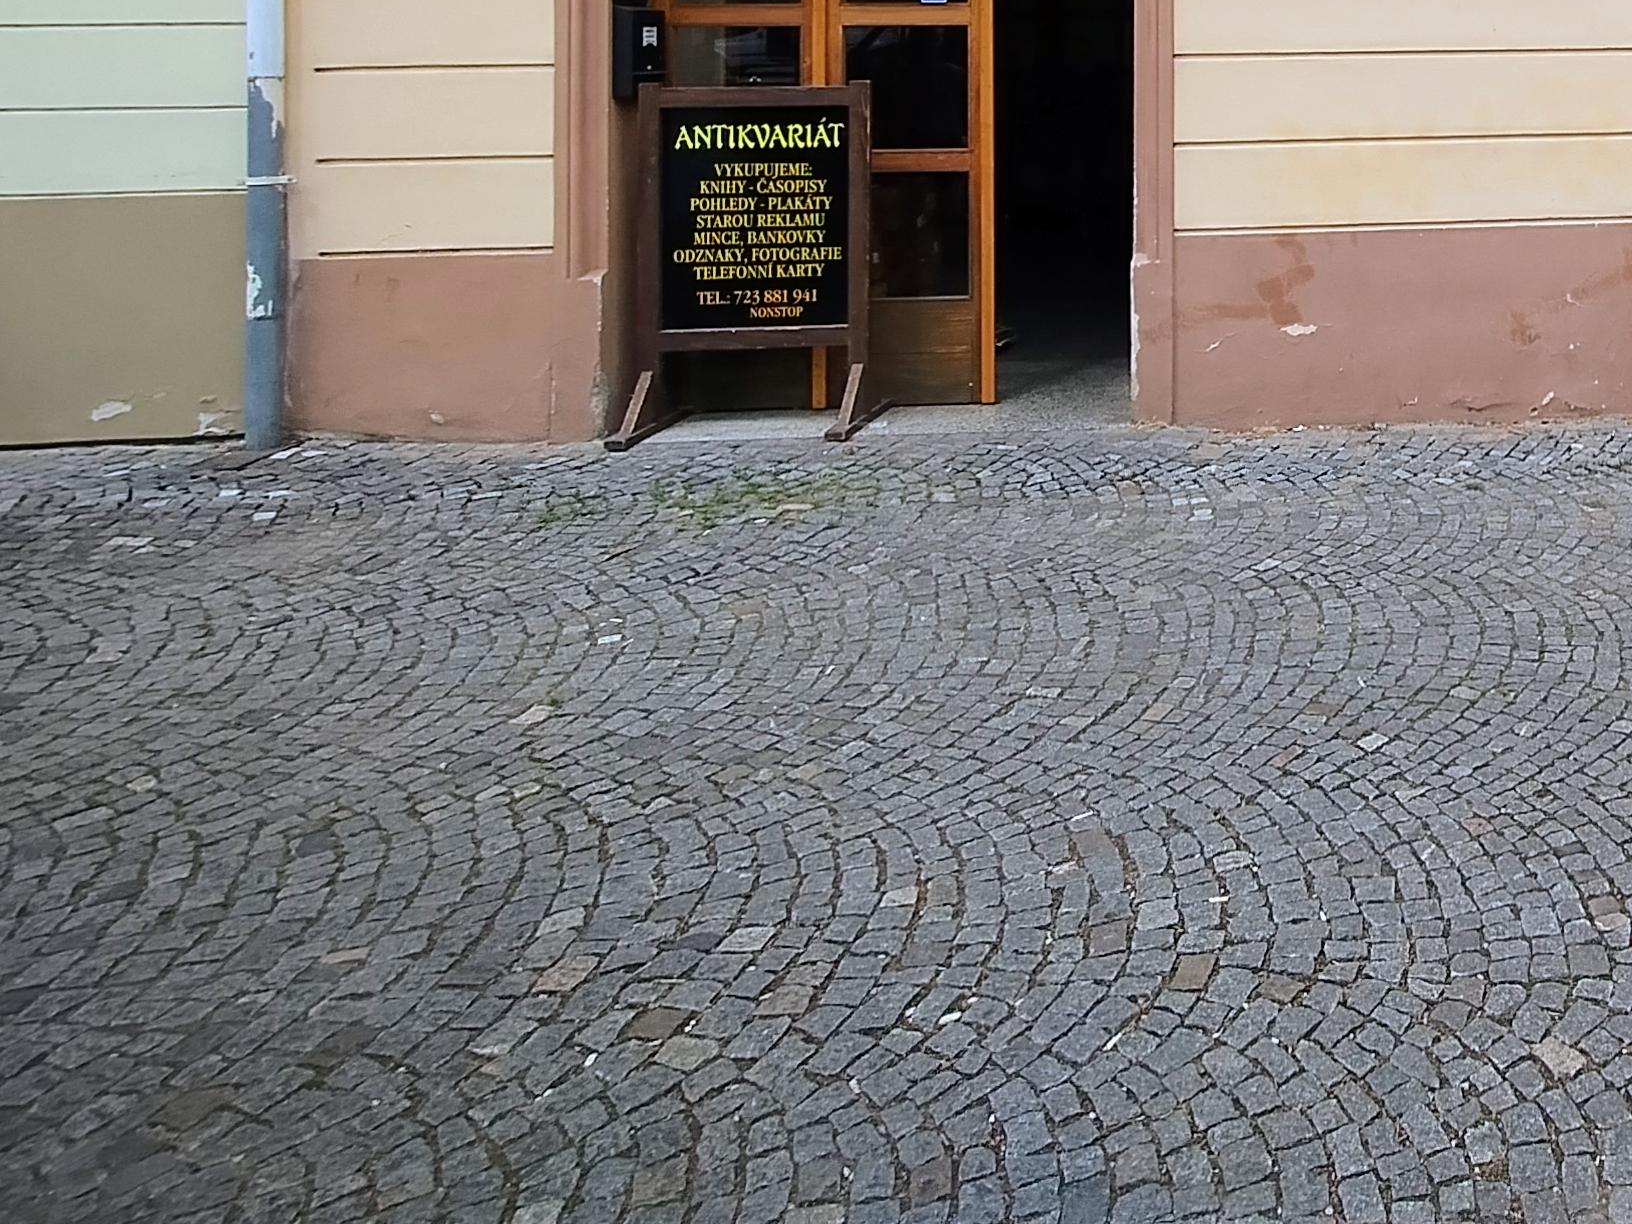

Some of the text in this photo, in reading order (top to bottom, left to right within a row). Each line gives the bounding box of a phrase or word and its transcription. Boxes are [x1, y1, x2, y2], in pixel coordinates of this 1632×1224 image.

[674, 117, 845, 150] ANTIKVARIÁT
[714, 163, 813, 179] VYKUPUJEME:
[700, 180, 747, 194] KNIHY
[756, 178, 828, 194] ČASOPISY
[690, 197, 758, 211] POHLEDY
[768, 194, 833, 210] PLAKÁTY
[696, 213, 826, 229] STAROU REKLAMU
[693, 230, 826, 247] MINCE, BANKOVKY
[673, 247, 842, 264] ODZNAKY, FOTOGRAFIE
[693, 262, 825, 280] TELEFONNÍ KARTY
[696, 288, 817, 305] TEL.: 723 881 941
[749, 306, 803, 318] NONSTOP
